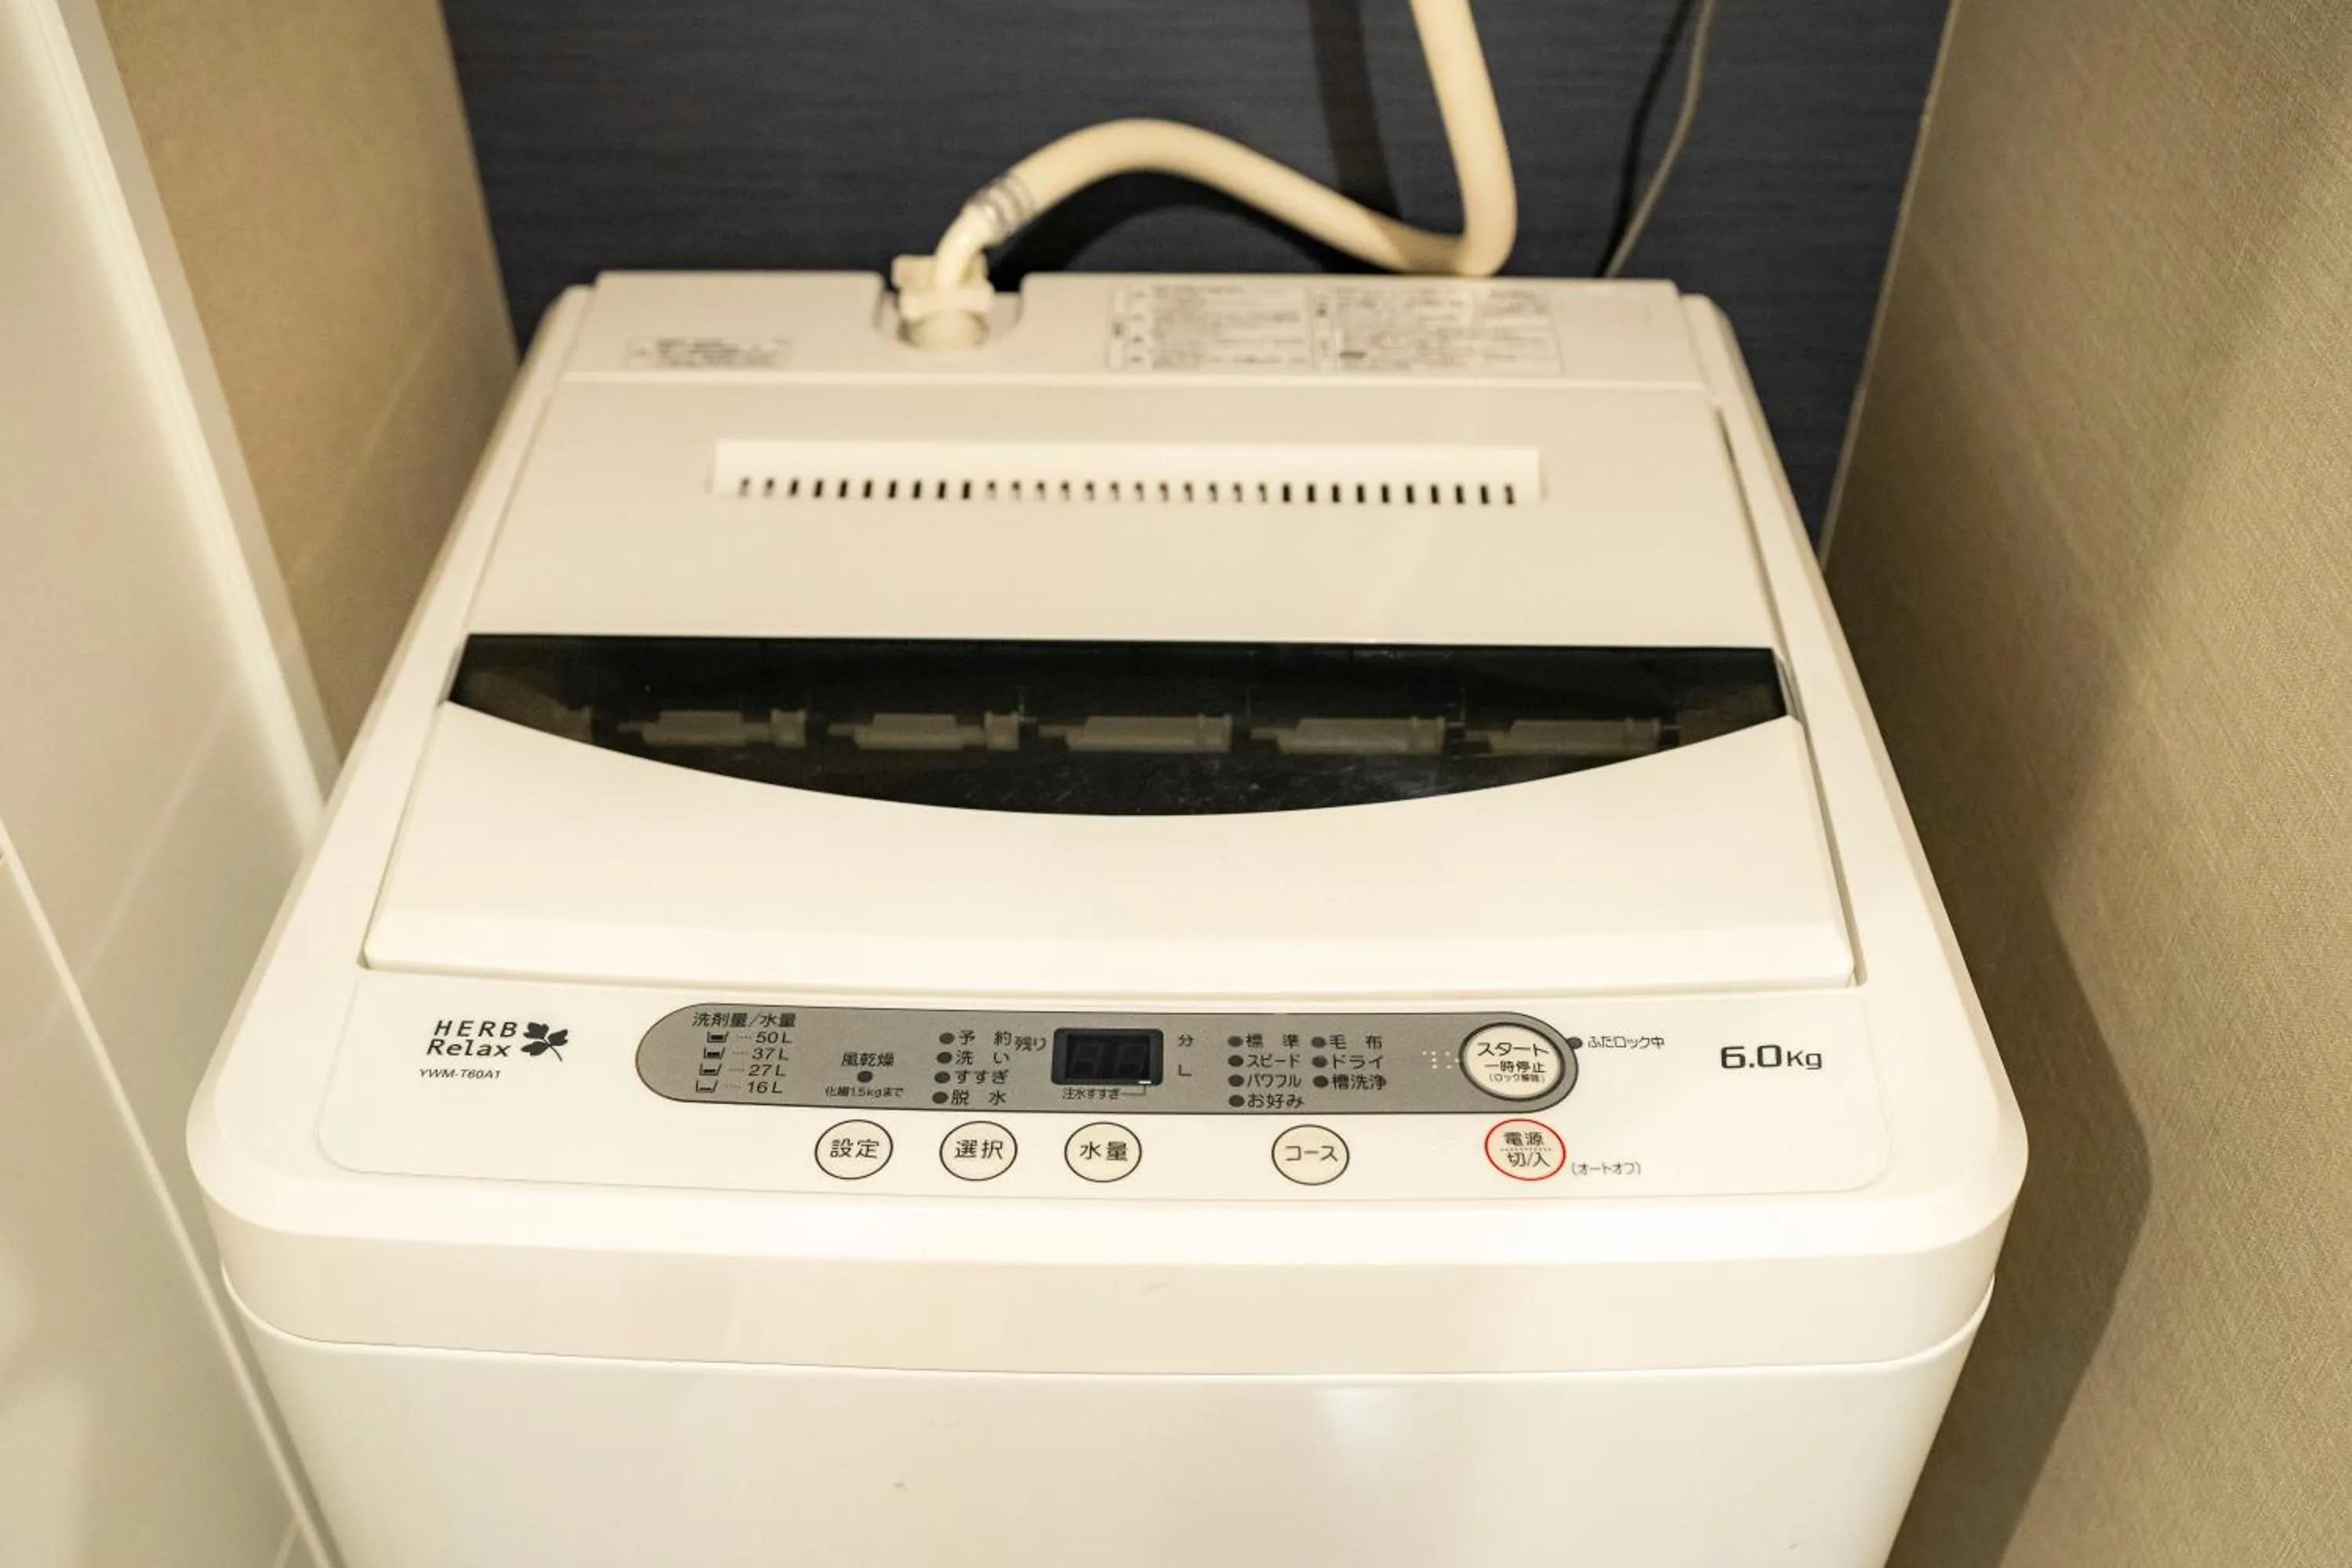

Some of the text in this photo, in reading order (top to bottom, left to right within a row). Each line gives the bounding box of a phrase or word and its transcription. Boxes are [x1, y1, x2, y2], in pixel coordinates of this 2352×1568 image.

[691, 1012, 796, 1028] 洗剤量/水量
[434, 1020, 517, 1037] HERB
[426, 1038, 511, 1057] Relax
[1014, 1036, 1047, 1051] 残り
[1178, 1034, 1193, 1047] 分
[1588, 1036, 1665, 1048] ふたロック中
[1477, 1042, 1550, 1057] スタート
[840, 1051, 895, 1067] 風乾燥
[1247, 1054, 1301, 1068] スピード
[1332, 1054, 1384, 1069] ドライ
[1485, 1061, 1547, 1073] 一時停止
[954, 1069, 1009, 1084] すすぎ
[1247, 1073, 1301, 1088] パワフル
[1332, 1074, 1387, 1091] 槽洗浄
[1062, 1087, 1120, 1100] 注水すすぎ
[1247, 1093, 1305, 1109] お好み
[1504, 1132, 1544, 1146] 電源
[829, 1138, 879, 1159] 設定
[954, 1139, 1004, 1160] 選択
[1079, 1141, 1129, 1160] 水量
[1286, 1145, 1338, 1162] コース
[1507, 1151, 1551, 1167] 切/入
[1571, 1161, 1642, 1176] (オートオフ)
